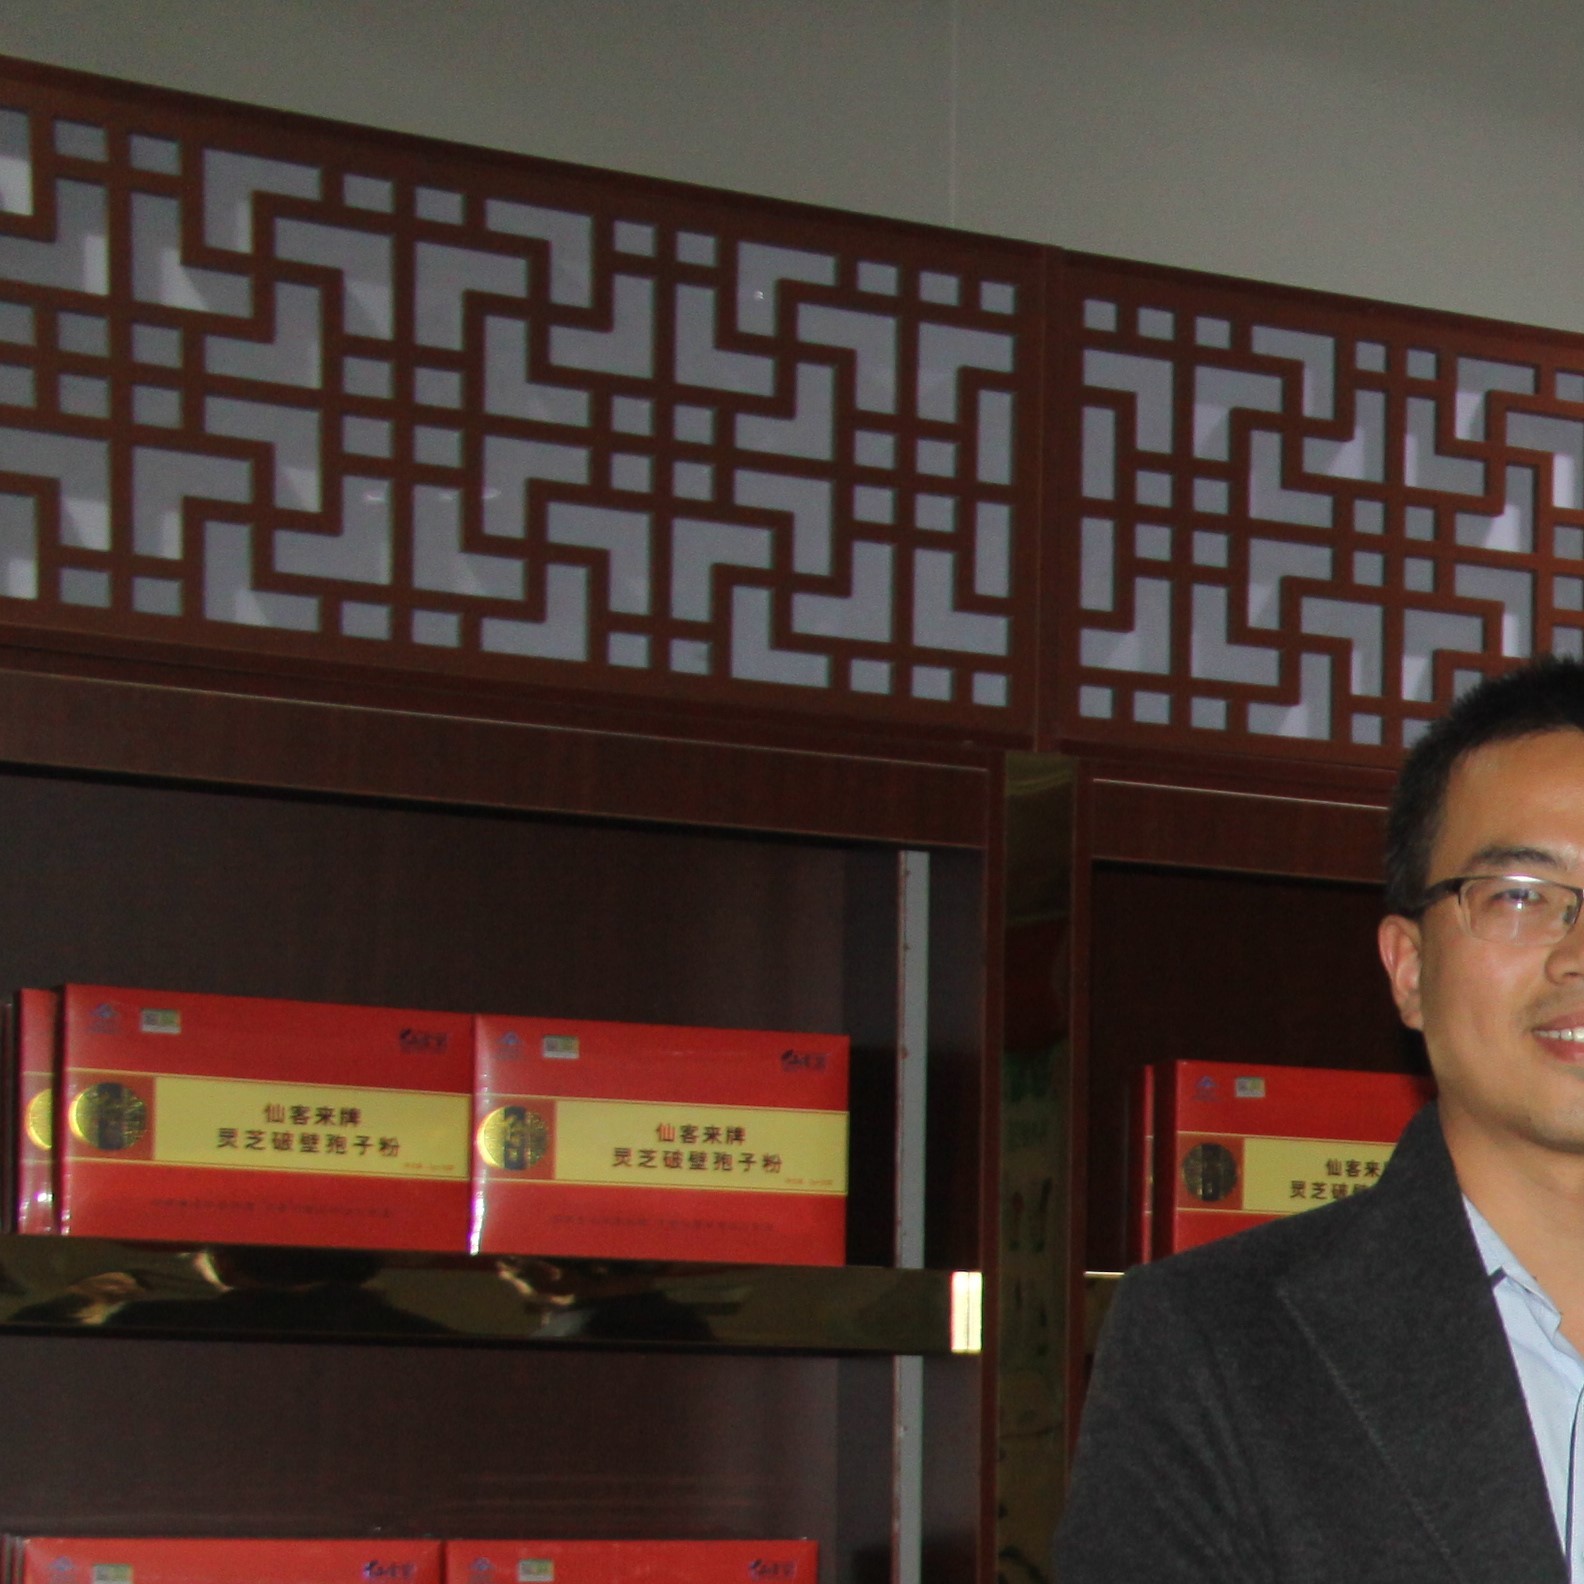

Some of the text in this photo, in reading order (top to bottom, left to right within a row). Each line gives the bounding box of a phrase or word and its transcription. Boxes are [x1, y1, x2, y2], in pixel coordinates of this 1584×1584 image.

[264, 1103, 361, 1127] 仙客来牌
[216, 1128, 400, 1157] 灵芝破壁孢子粉
[656, 1122, 746, 1145] 仙客来牌
[612, 1147, 782, 1173] 灵芝破壁孢子粉
[1326, 1159, 1385, 1177] 仙客来
